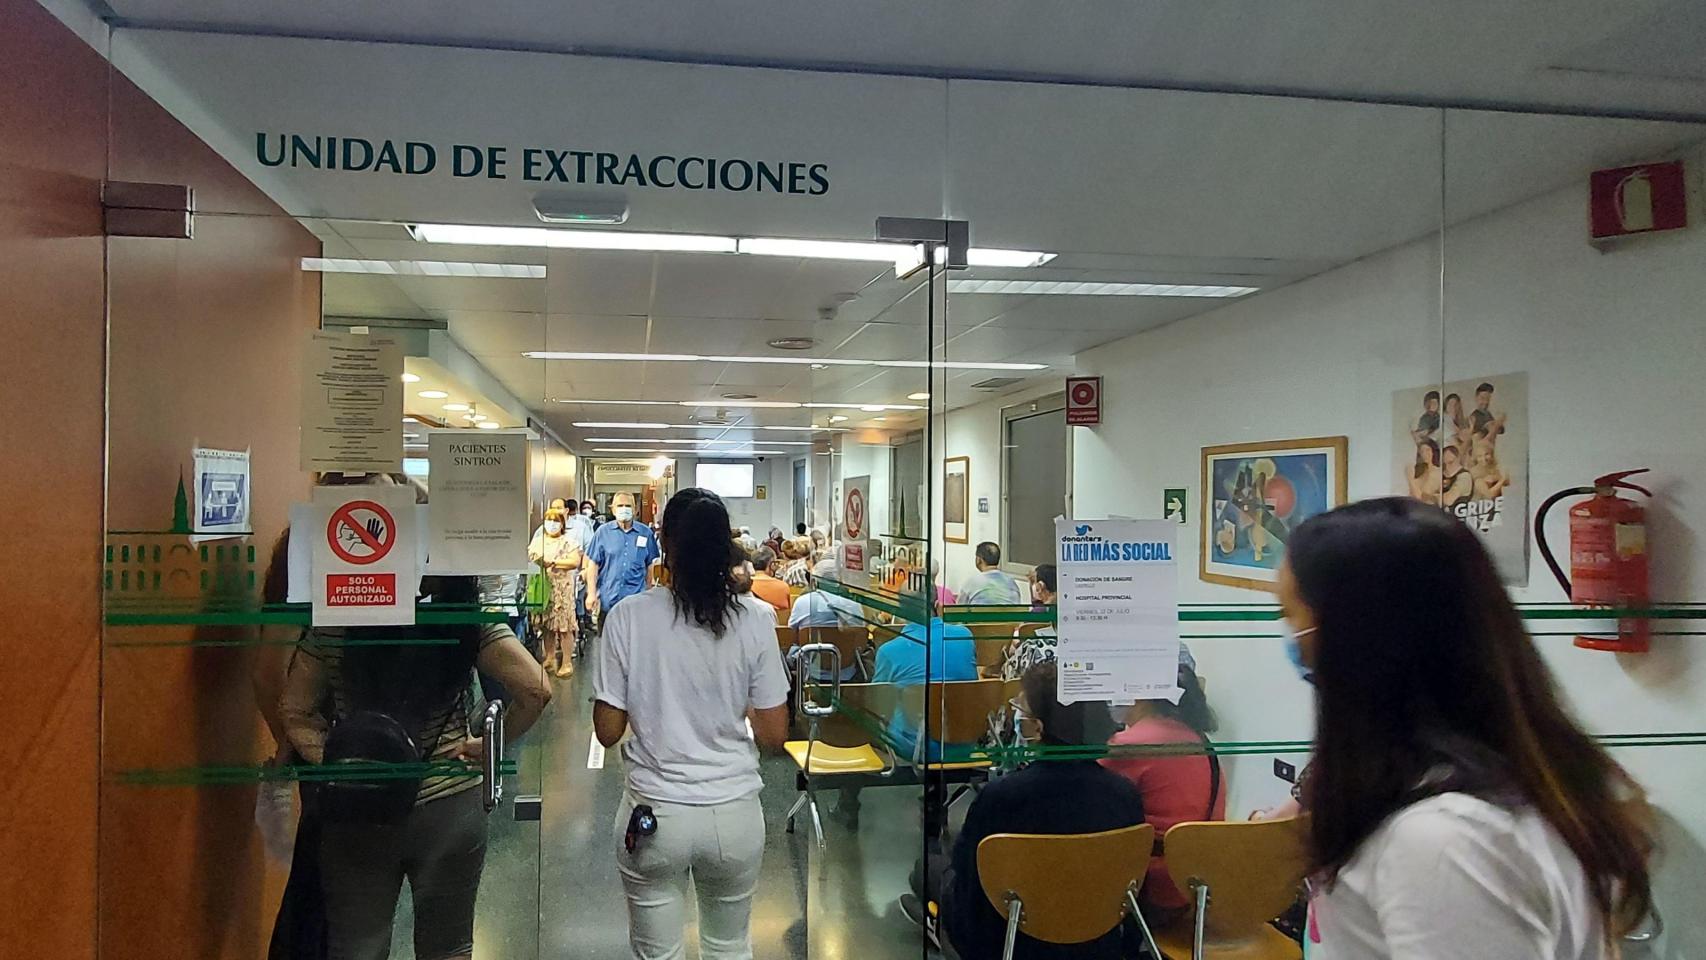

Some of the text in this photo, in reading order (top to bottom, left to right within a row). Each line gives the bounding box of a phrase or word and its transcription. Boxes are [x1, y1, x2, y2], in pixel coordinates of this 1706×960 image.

[256, 132, 830, 196] UNIDAD DE EXTRACCIONES
[449, 444, 507, 454] PACIENTES
[454, 456, 502, 466] SINTRON
[1062, 540, 1172, 561] LA RED MÁS SOCIAL
[348, 576, 375, 585] SOLO
[335, 585, 387, 594] PERSONAL
[330, 594, 393, 603] AUTORIZADO
